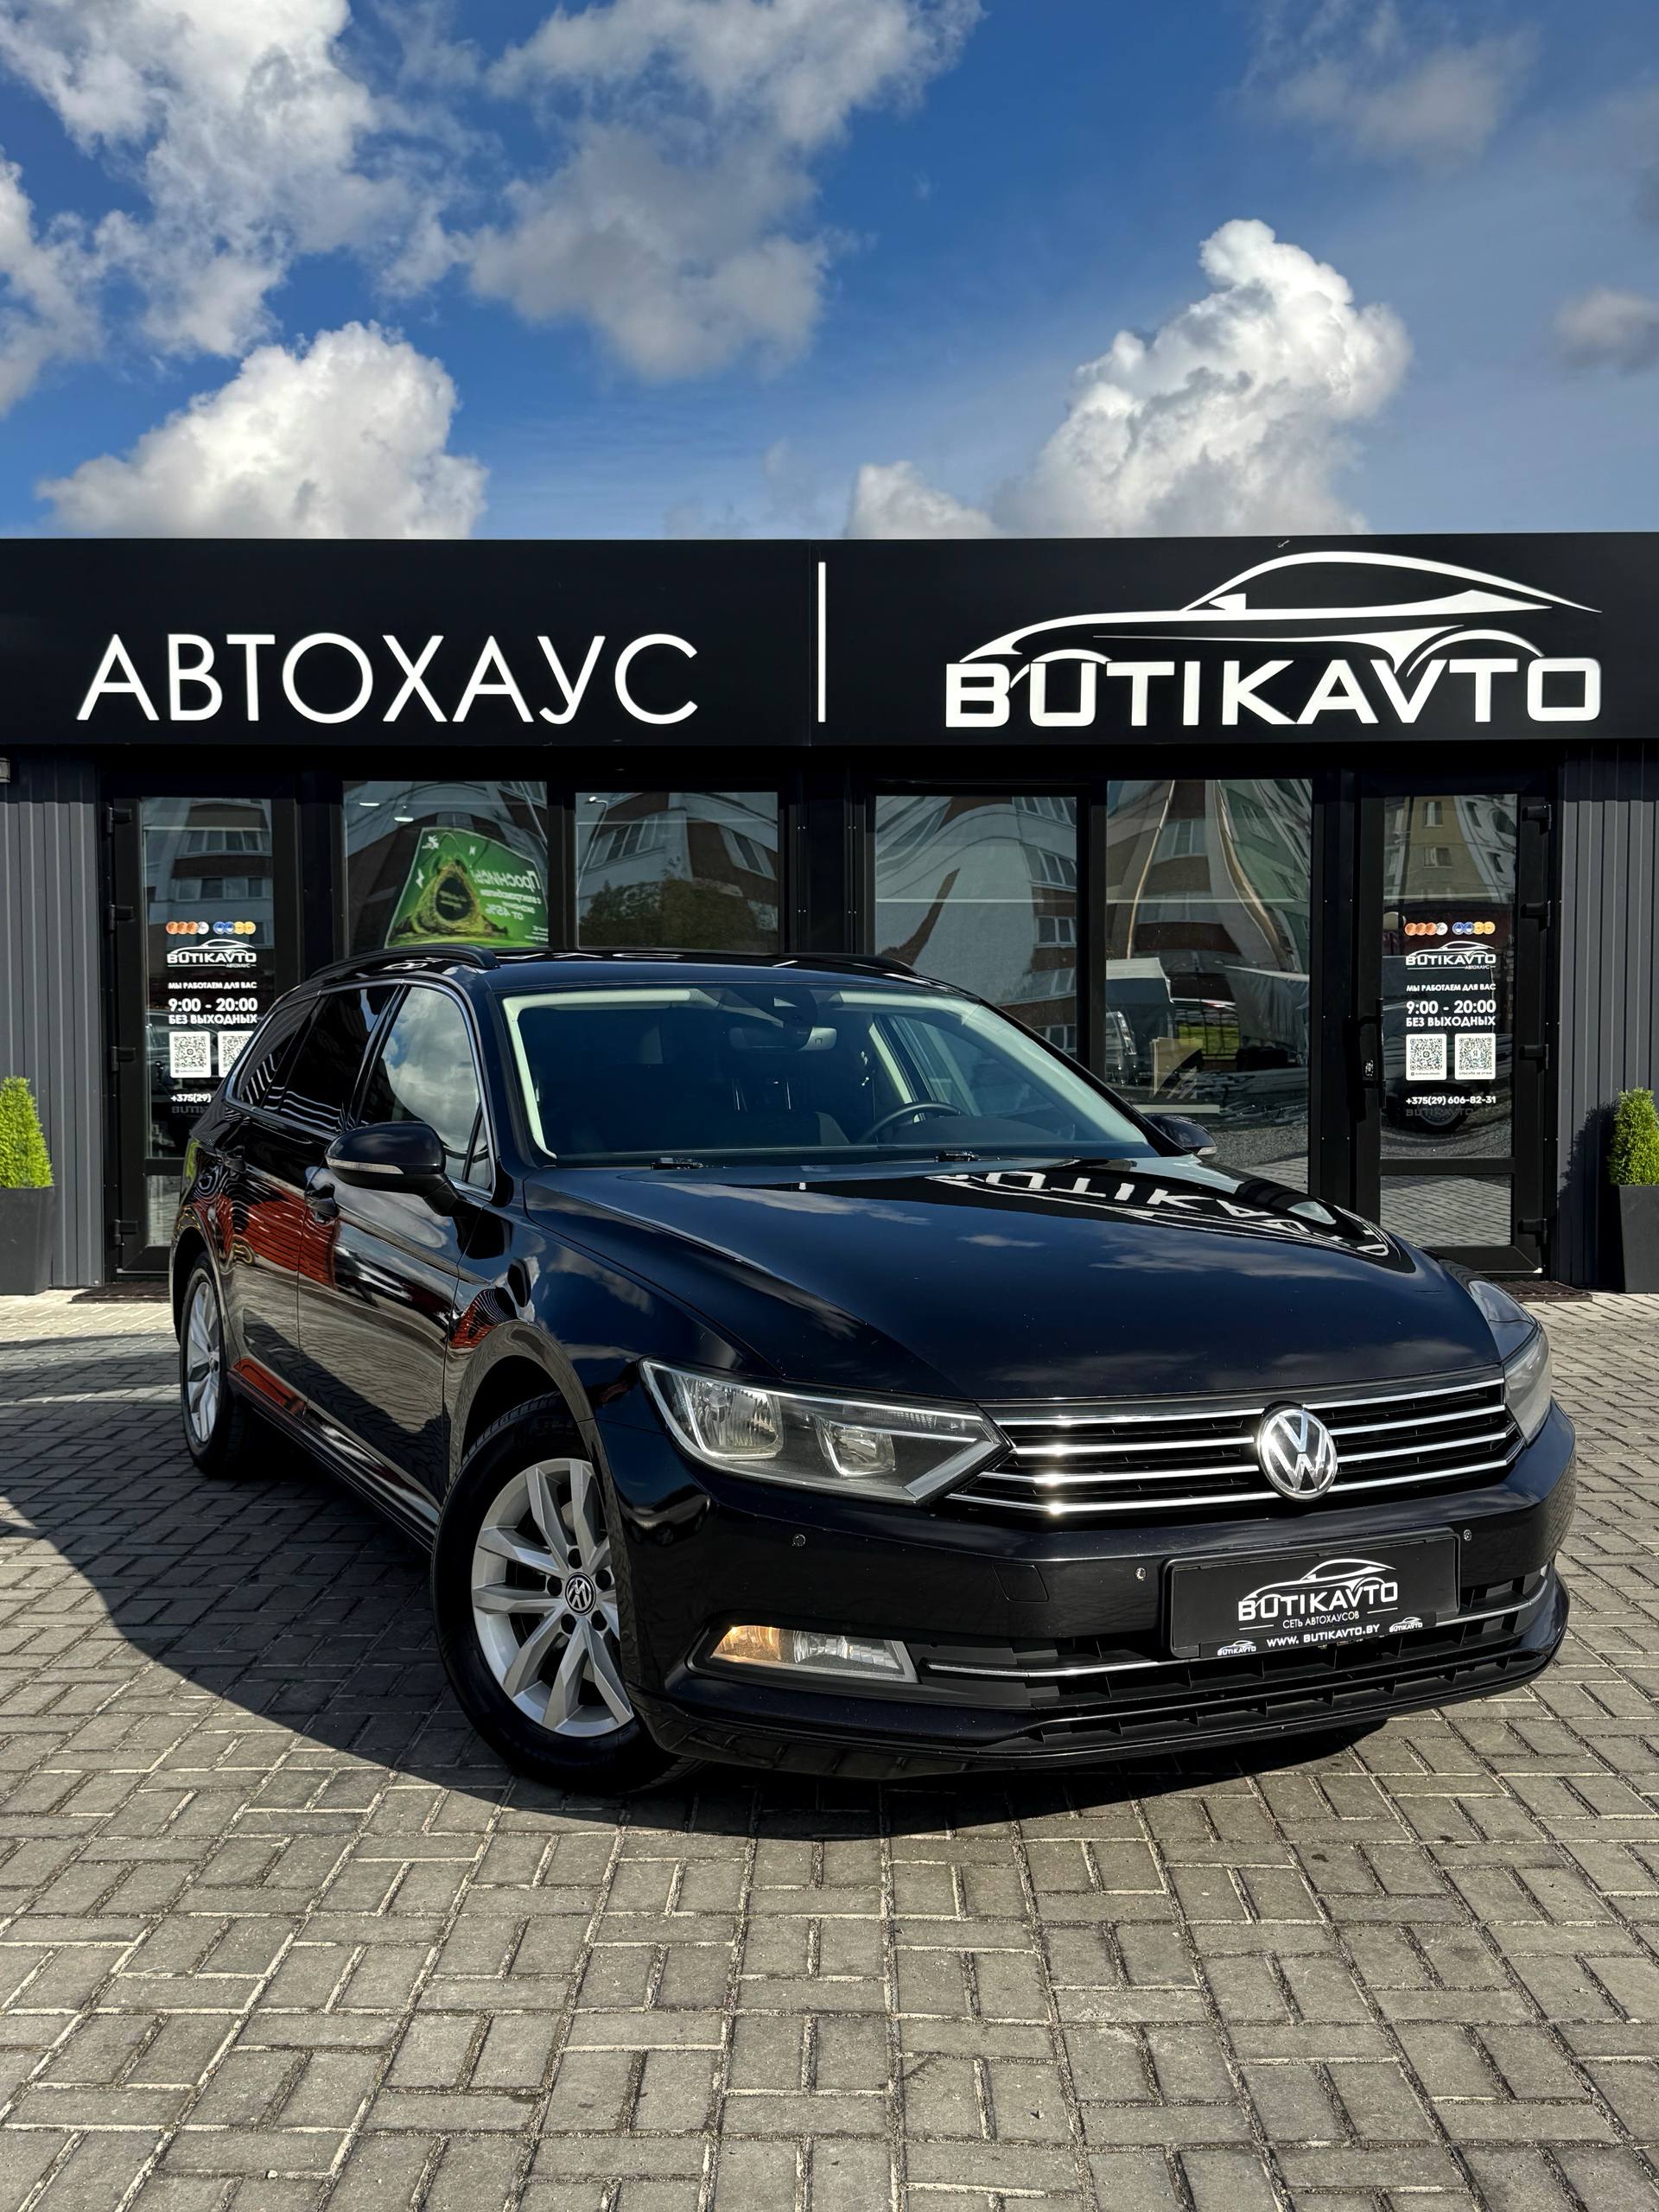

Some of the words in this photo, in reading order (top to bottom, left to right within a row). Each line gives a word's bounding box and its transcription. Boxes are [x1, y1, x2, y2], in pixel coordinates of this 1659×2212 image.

[77, 632, 698, 725] АВТОХАУС
[945, 657, 1603, 728] BUTIKAVTO
[167, 952, 257, 964] BUTIKAVTO
[1405, 954, 1497, 966] BUTIKAVTO
[224, 982, 239, 990] ДЛЯ
[168, 998, 201, 1012] 9:00
[216, 997, 258, 1012] 20:00
[1406, 1001, 1439, 1014] 9:00
[1453, 1000, 1497, 1014] 20:00
[168, 1014, 188, 1025] БЕЗ
[190, 1014, 257, 1025] ВЫХОДНЫХ
[1406, 1017, 1425, 1027] БЕЗ
[1427, 1015, 1496, 1027] ВЫХОДНЫХ
[170, 1093, 212, 1103] +375(29)
[1406, 1096, 1446, 1106] +375(29)
[1447, 1095, 1497, 1104] 606-82-31
[1238, 1581, 1399, 1622] BUTIKAVTO
[1282, 1618, 1303, 1630] СЕТЬ
[1305, 1611, 1360, 1626] АВТОХАУСОВ
[1389, 1621, 1423, 1633] BUTIKAVTO
[1266, 1635, 1300, 1648] WWW.
[1303, 1624, 1381, 1643] BUTIKAVTO.BY
[1217, 1645, 1257, 1656] BUTIKAVTO
